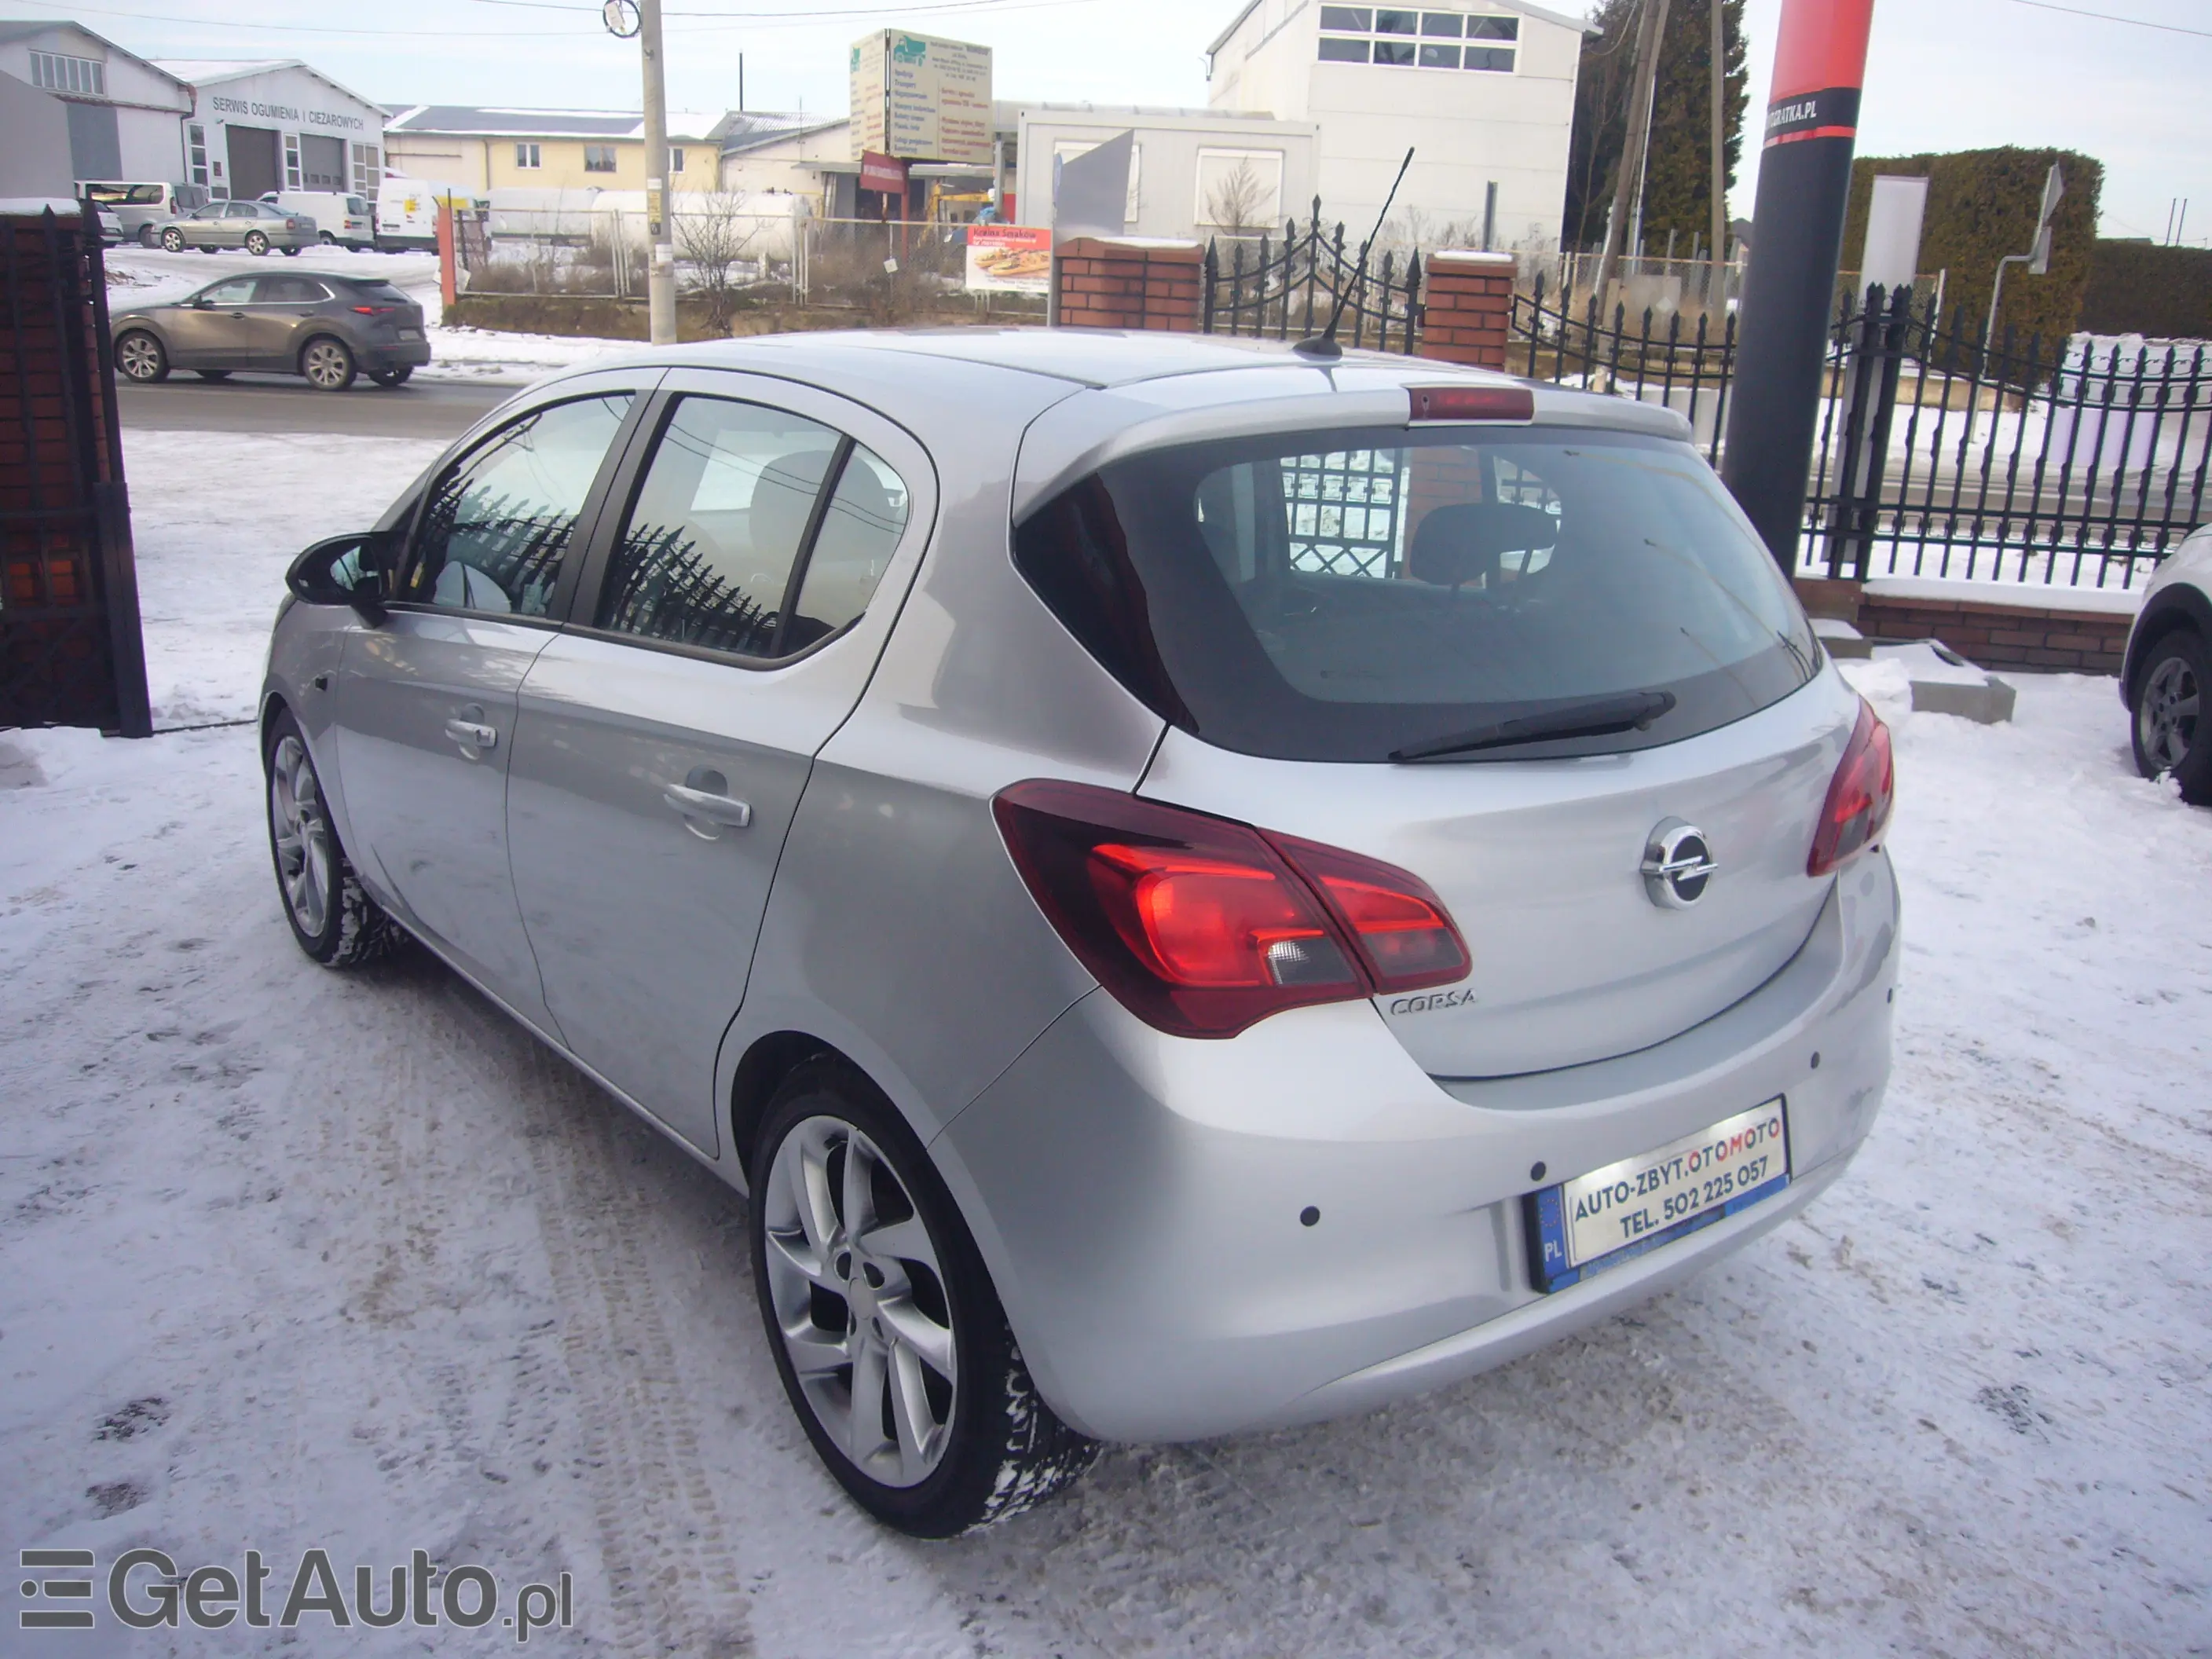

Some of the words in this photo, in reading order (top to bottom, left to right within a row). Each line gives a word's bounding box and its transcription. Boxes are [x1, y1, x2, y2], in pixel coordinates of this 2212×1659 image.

[213, 97, 248, 115] SERWIS
[251, 103, 299, 122] OGUMIENIA
[1390, 987, 1478, 1016] CORSA
[1575, 1118, 1780, 1222] AUTO-ZBYT.OTOMOTO
[1619, 1209, 1660, 1239] TEL.
[1663, 1187, 1699, 1220] 502
[1703, 1172, 1734, 1205] 225
[1737, 1155, 1769, 1187] 057
[1544, 1240, 1562, 1262] PL
